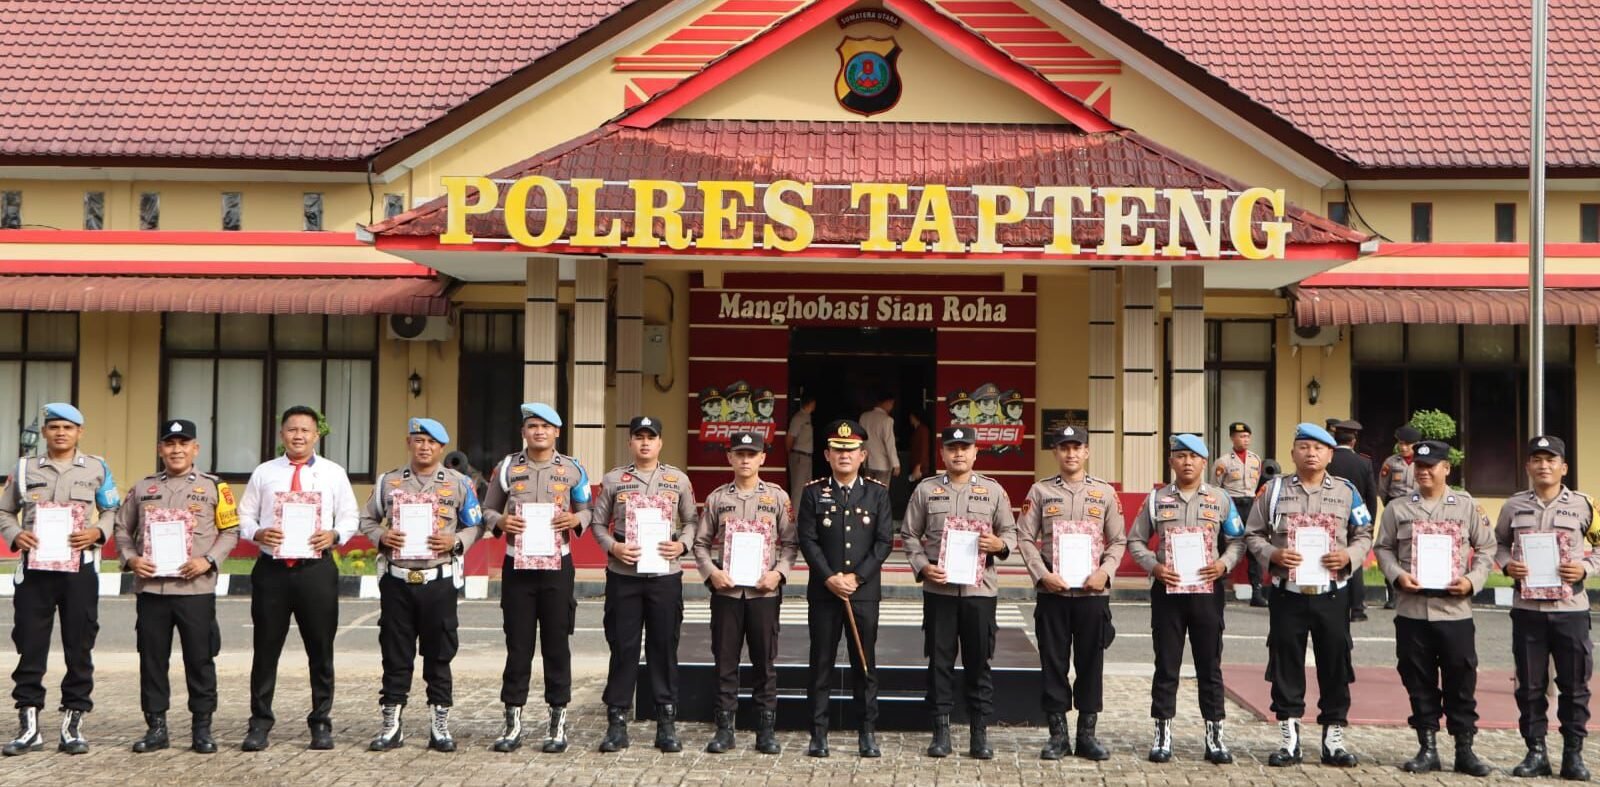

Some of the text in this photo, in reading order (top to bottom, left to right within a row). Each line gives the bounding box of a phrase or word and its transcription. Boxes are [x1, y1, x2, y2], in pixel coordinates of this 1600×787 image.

[841, 12, 898, 24] SUMATERA UTARA
[439, 175, 1293, 260] POLRES TAPTENG
[718, 293, 1007, 325] Manghobasi Sian Roha
[550, 475, 569, 484] POLRI
[658, 483, 681, 491] POLRI
[187, 494, 209, 502] POLRI
[1323, 496, 1345, 505] POLRI
[757, 505, 777, 514] POLRI
[1199, 503, 1220, 512] POLRI
[1556, 509, 1580, 519] POLRI
